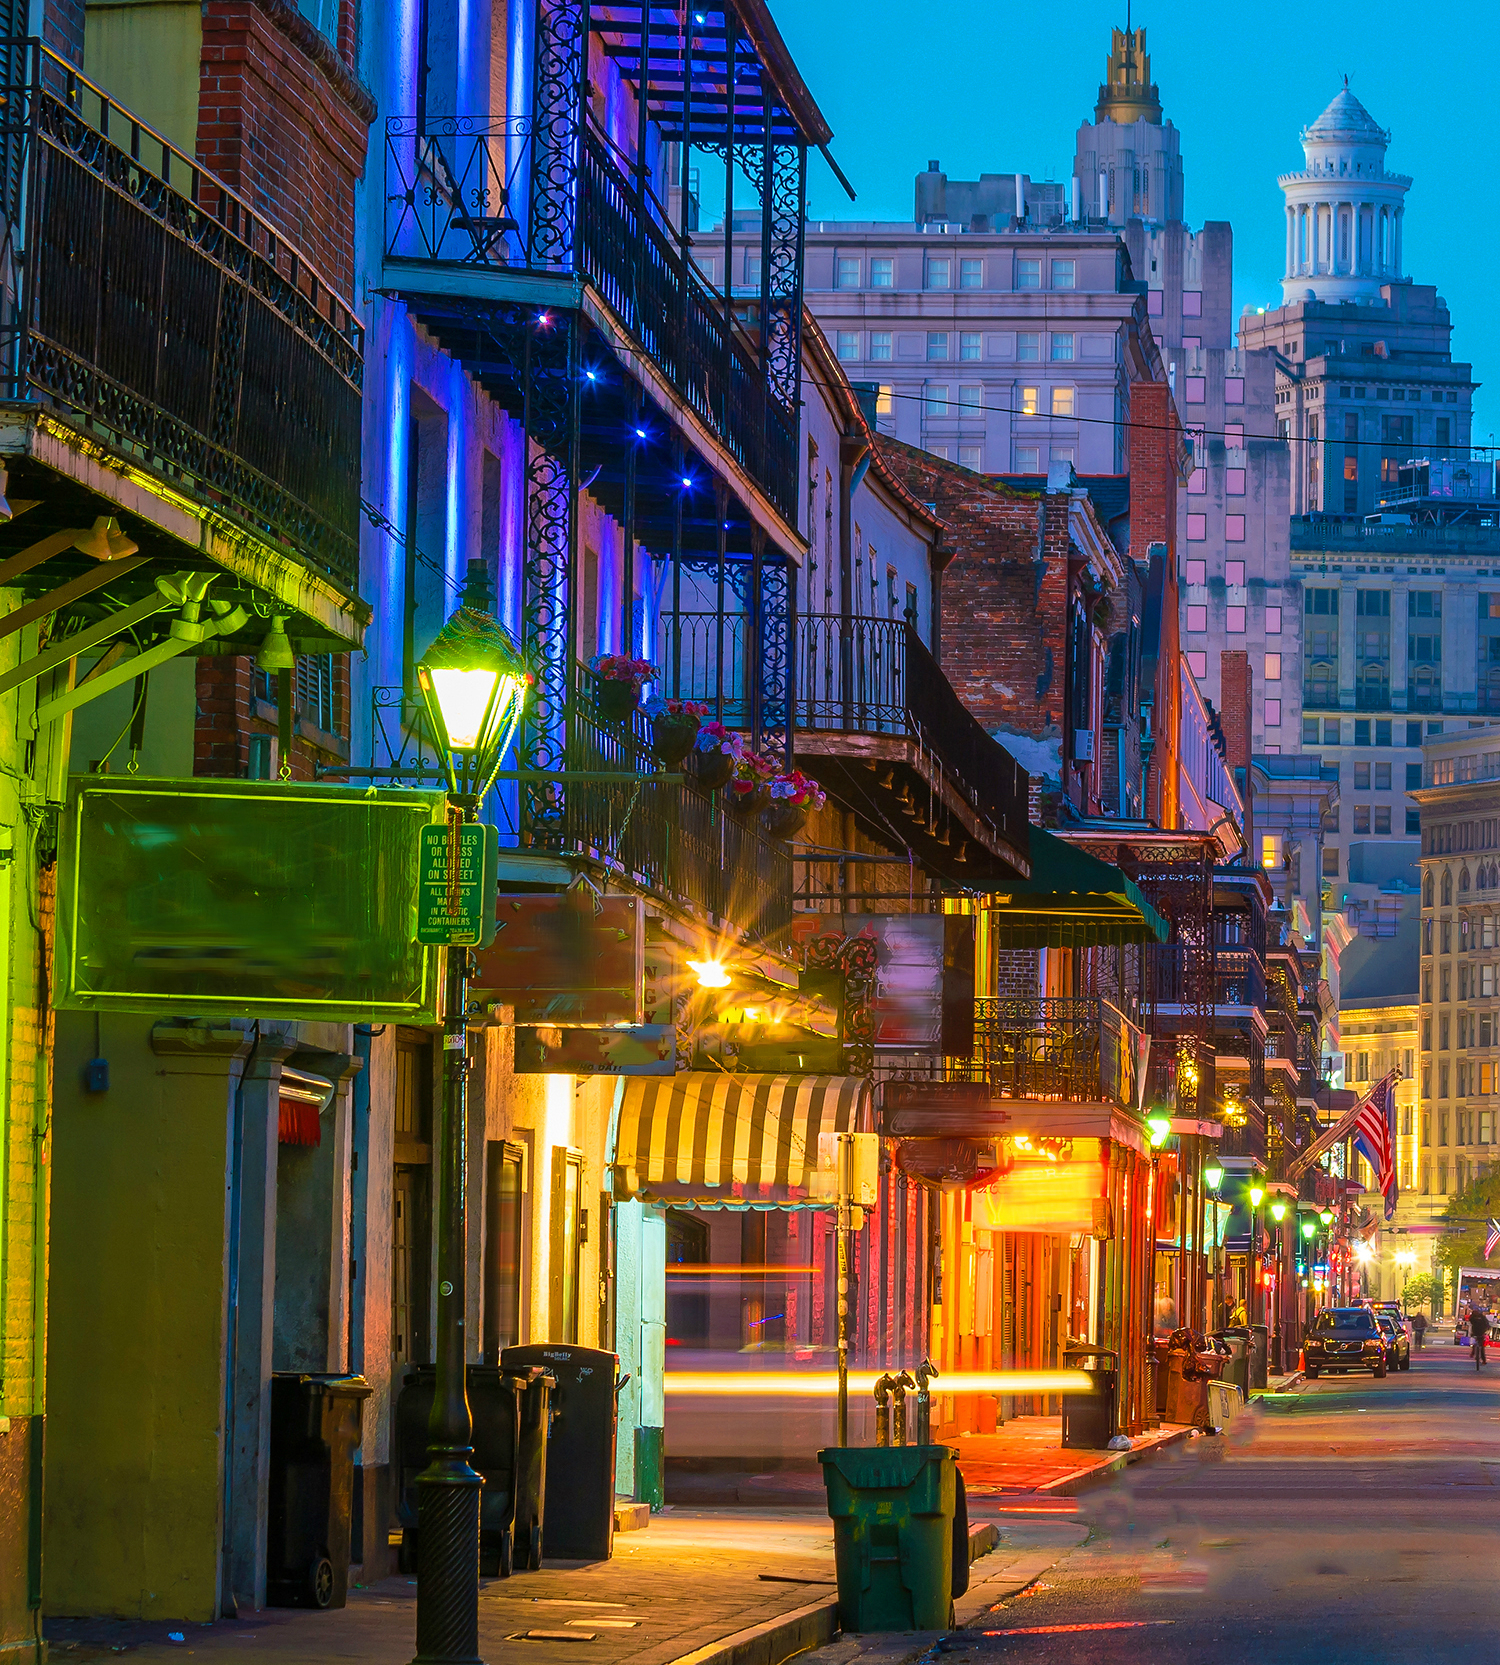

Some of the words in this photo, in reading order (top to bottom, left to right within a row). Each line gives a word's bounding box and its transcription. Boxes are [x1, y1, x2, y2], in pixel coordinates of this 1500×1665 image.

[427, 835, 439, 845] NO
[441, 835, 478, 846] BLES
[431, 846, 442, 857] OR
[427, 869, 440, 880] ON
[442, 869, 474, 880] STEET
[430, 887, 442, 896] ALL
[430, 907, 439, 916] IN
[427, 916, 471, 926] CONTAINERS
